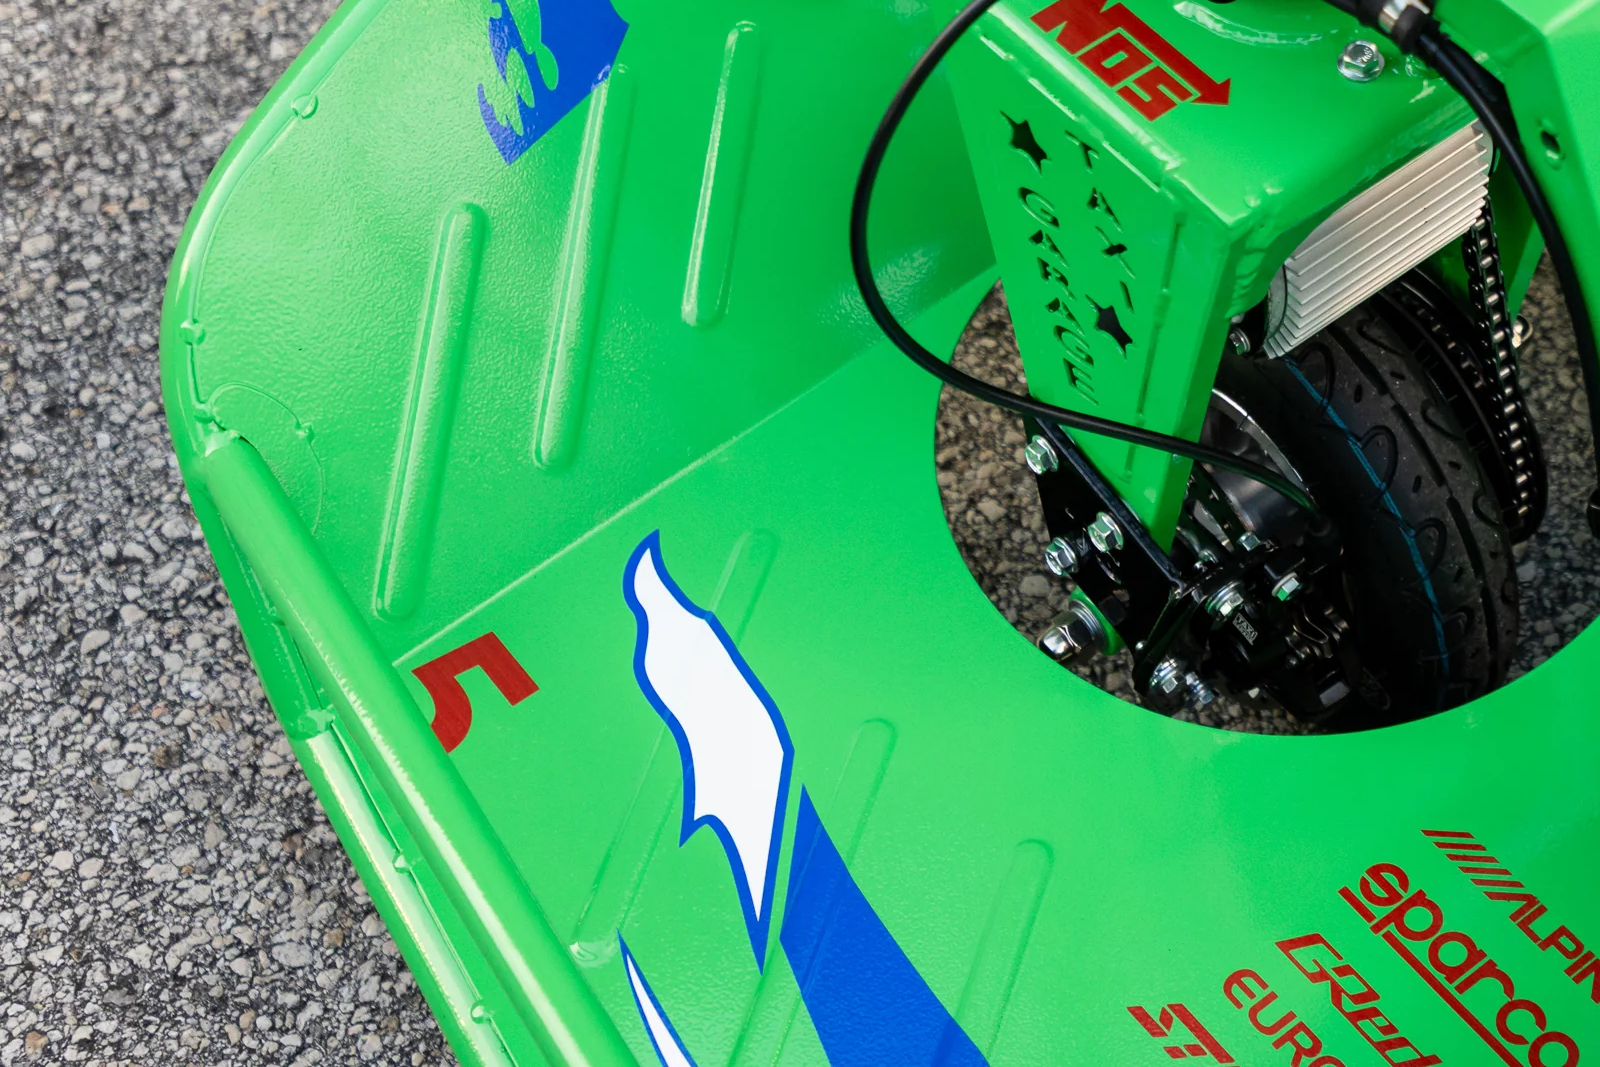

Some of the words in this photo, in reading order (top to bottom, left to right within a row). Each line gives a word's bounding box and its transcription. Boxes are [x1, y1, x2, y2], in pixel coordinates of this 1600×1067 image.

[1065, 129, 1137, 315] TAXI
[411, 630, 540, 754] 5
[1359, 862, 1580, 1067] sparco
